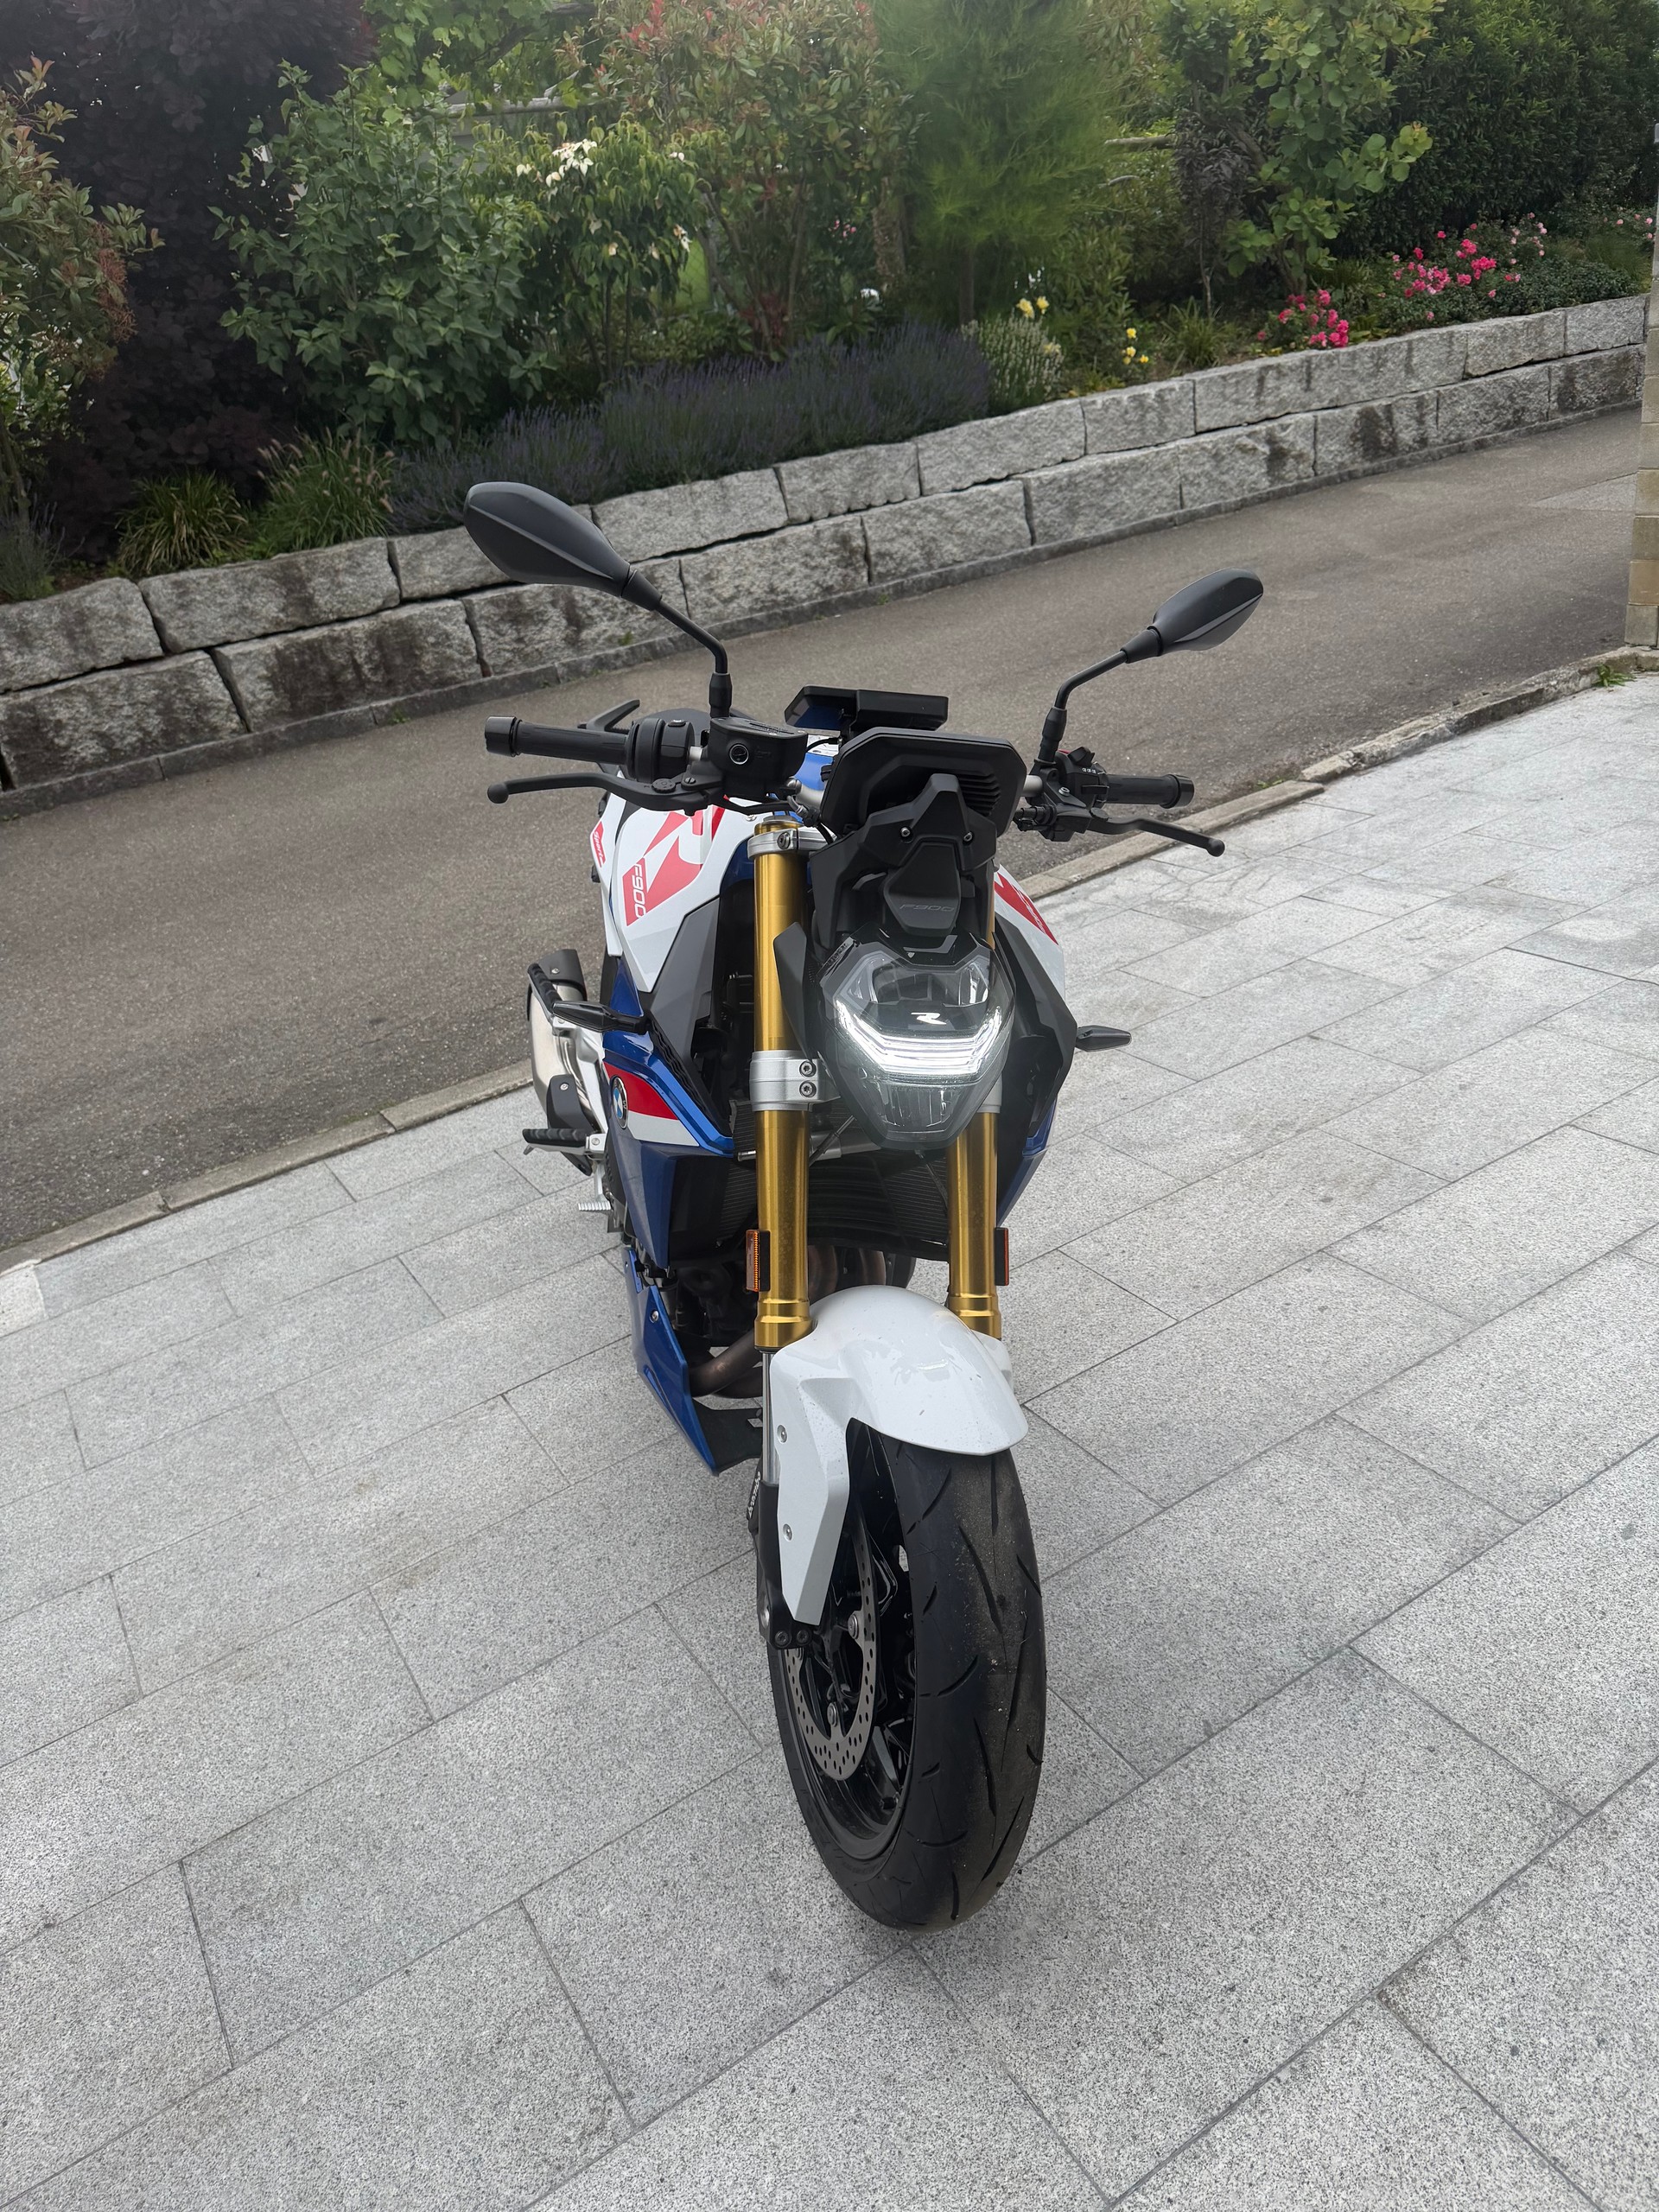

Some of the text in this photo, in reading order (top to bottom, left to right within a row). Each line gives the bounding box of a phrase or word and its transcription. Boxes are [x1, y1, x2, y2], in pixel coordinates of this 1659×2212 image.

[632, 864, 647, 918] F900
[899, 904, 955, 912] F900
[748, 1471, 761, 1519] brembo
